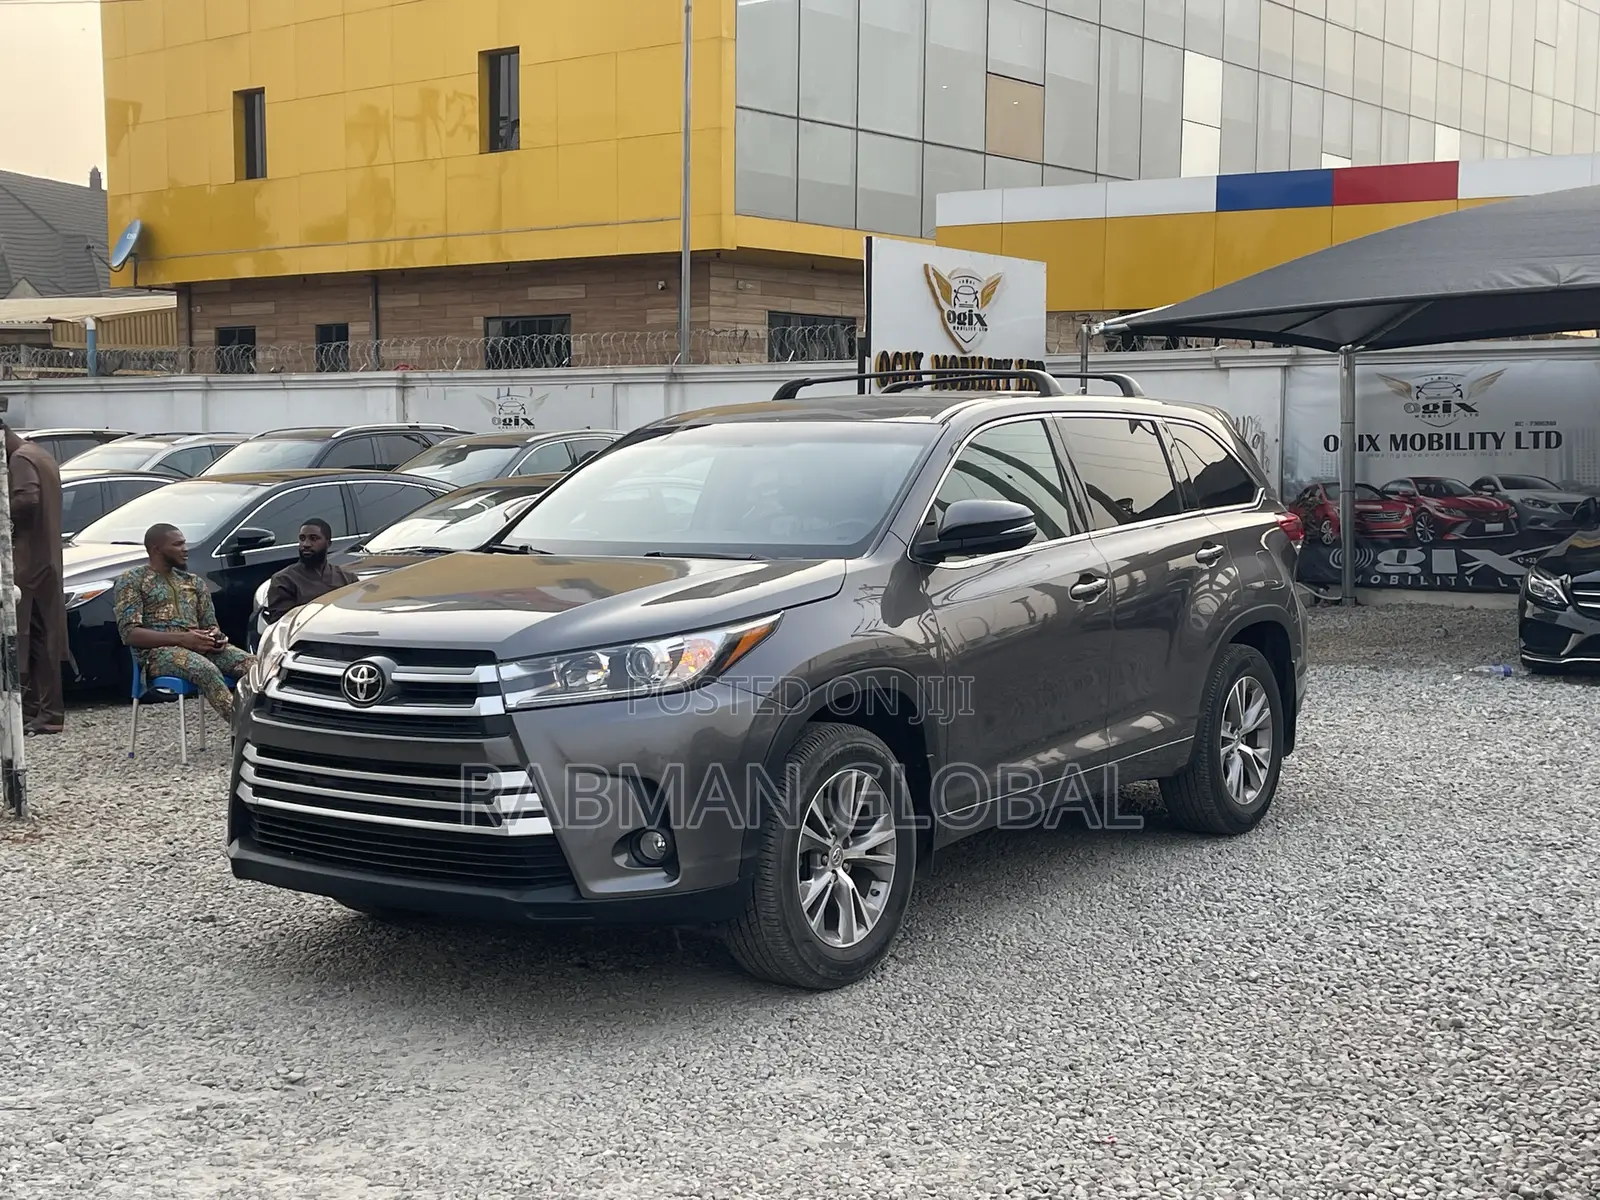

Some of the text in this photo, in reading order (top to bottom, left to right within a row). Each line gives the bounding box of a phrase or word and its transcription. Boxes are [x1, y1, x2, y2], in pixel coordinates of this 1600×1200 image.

[1323, 430, 1563, 453] OIX MOBILITY LTD
[1499, 577, 1523, 588] LT
